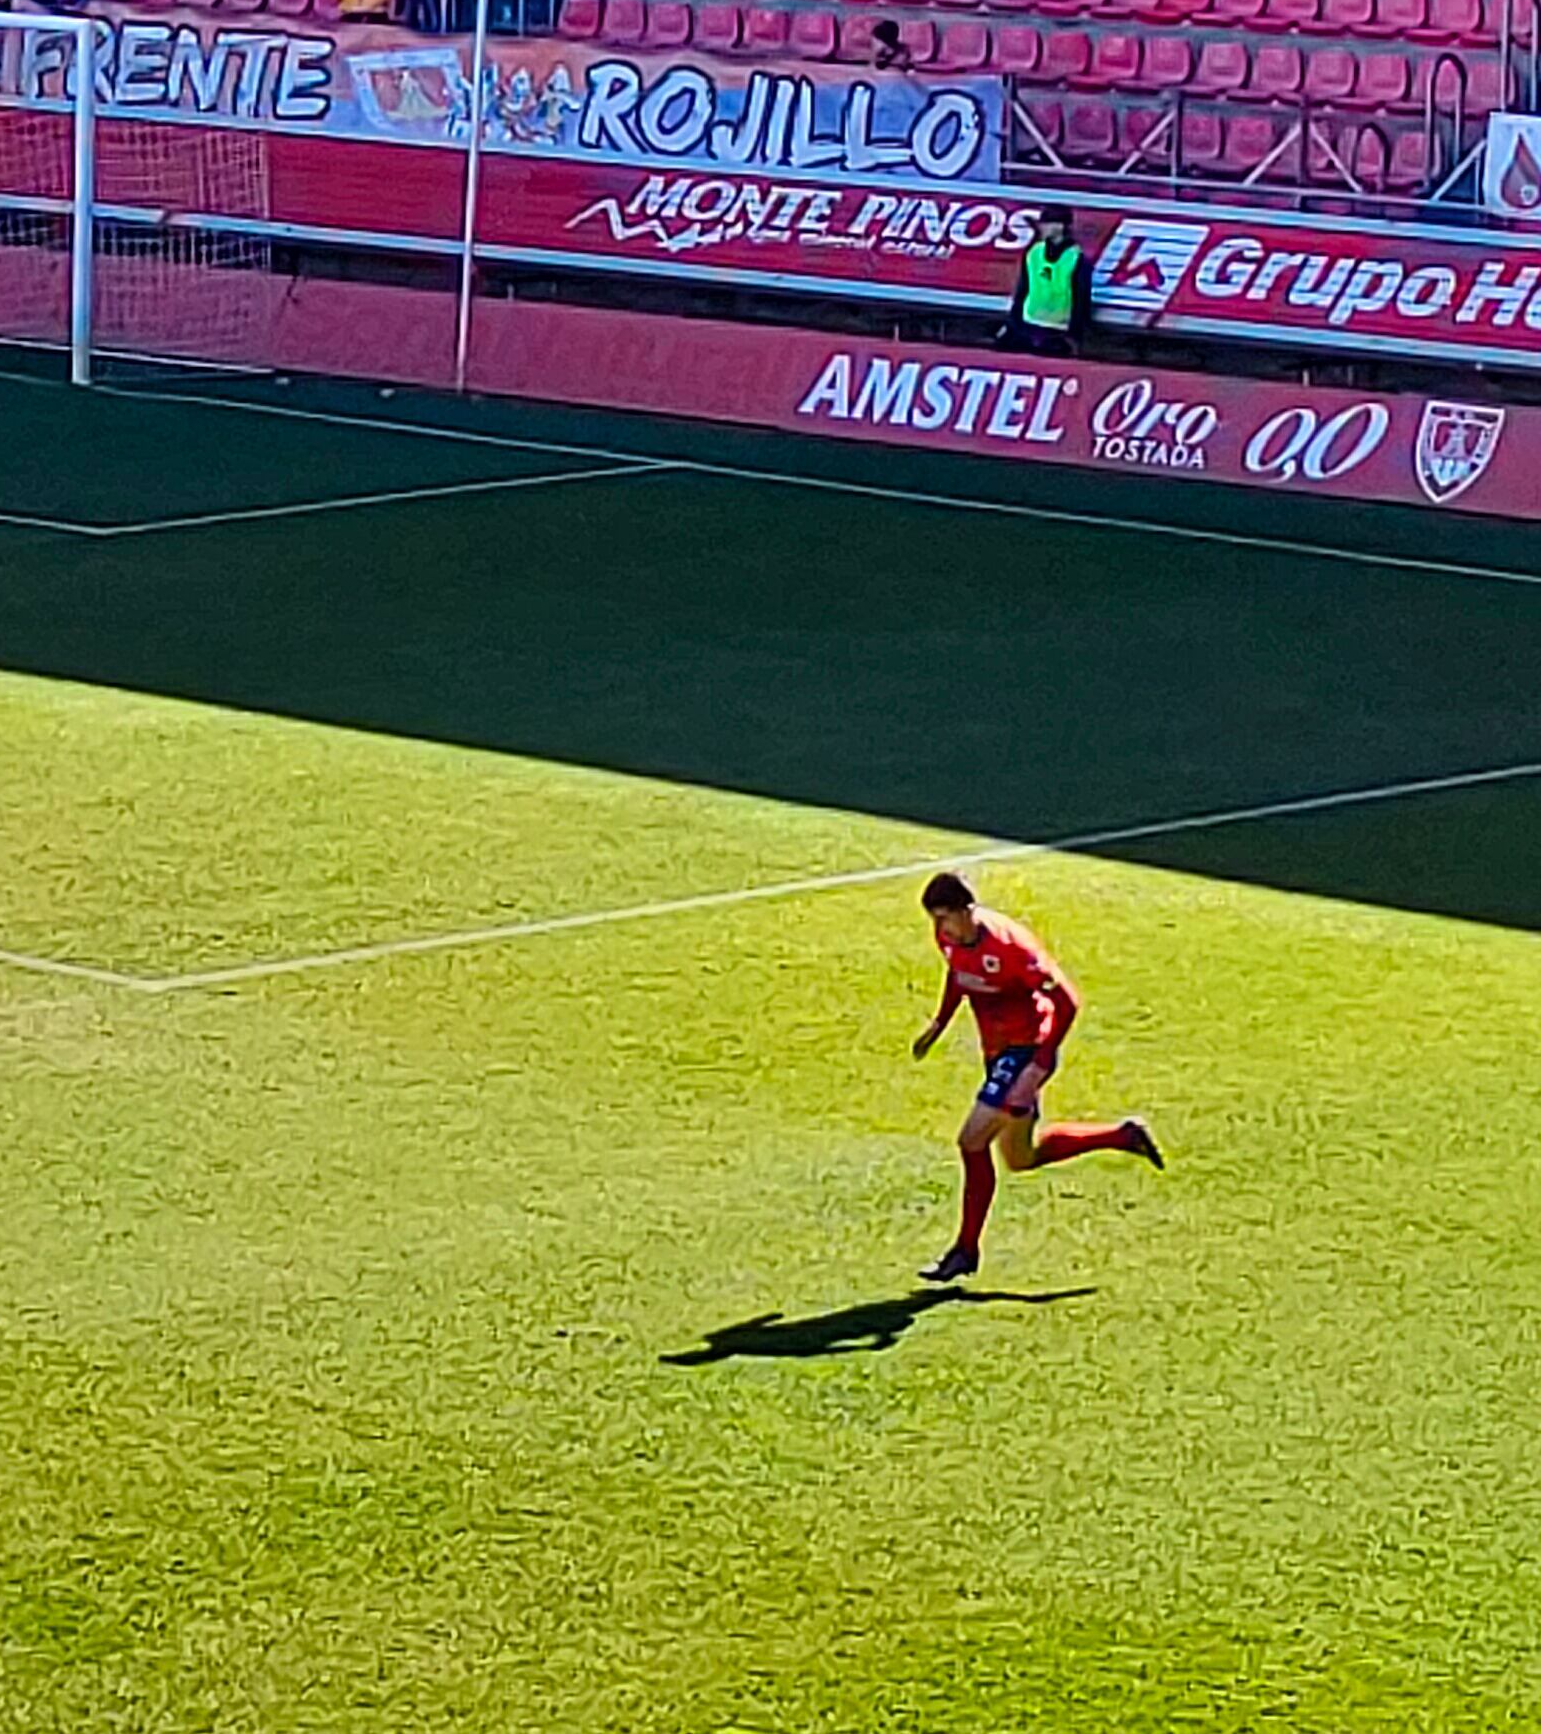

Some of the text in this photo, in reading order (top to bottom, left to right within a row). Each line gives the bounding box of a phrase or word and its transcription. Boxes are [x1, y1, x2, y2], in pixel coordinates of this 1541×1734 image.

[20, 18, 984, 178] FRENTE ROJILLO
[627, 175, 843, 234] MONTE
[848, 193, 1042, 250] PINOS
[1195, 239, 1457, 326] Grupo
[798, 354, 1069, 444] AMSTEL
[1093, 379, 1216, 446] Oro
[1093, 436, 1205, 469] TOSTADA
